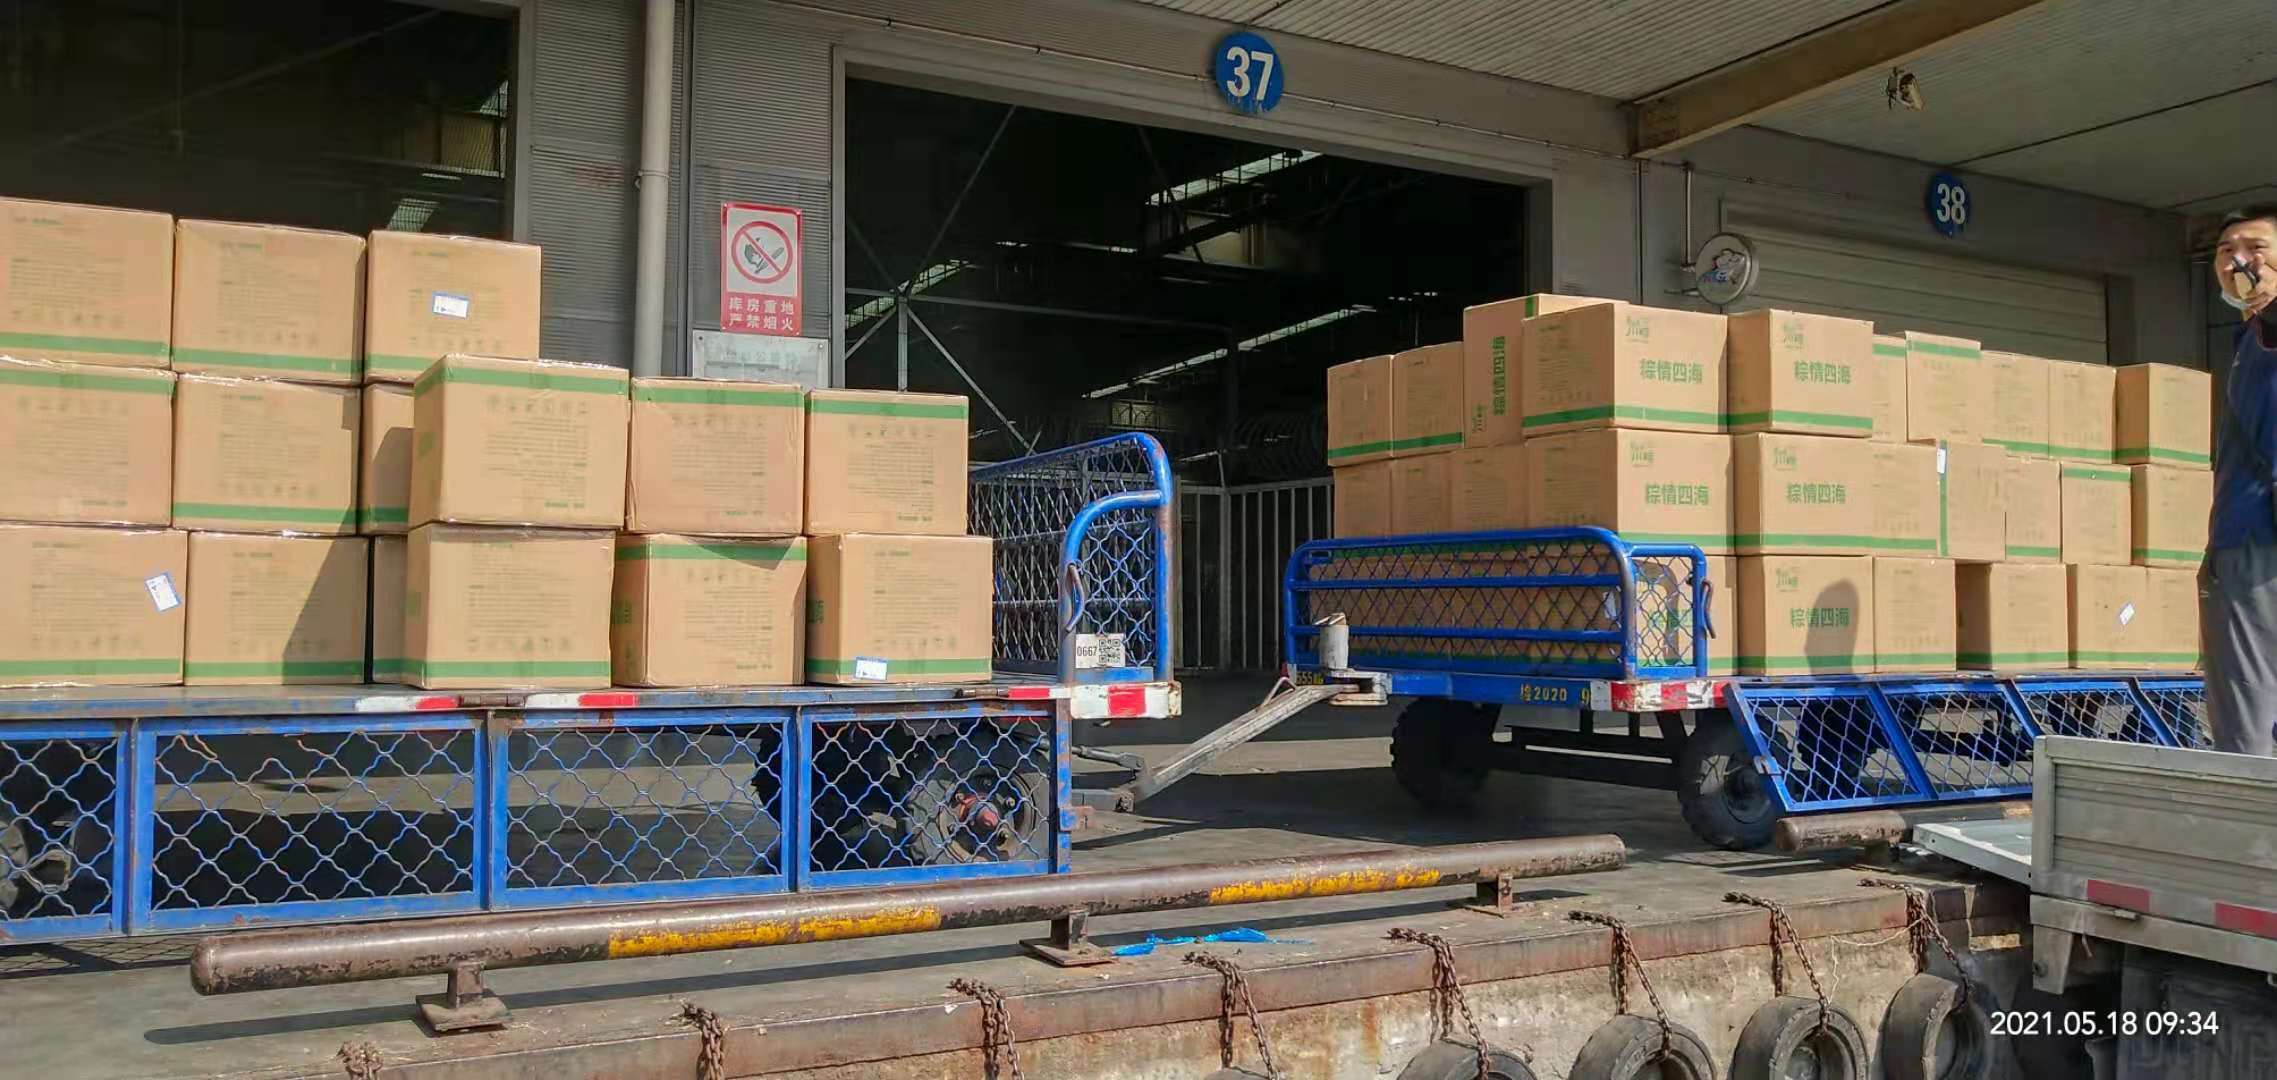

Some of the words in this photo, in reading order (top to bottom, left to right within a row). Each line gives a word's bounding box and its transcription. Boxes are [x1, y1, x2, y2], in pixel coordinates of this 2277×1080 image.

[1226, 46, 1274, 101] 37
[1936, 183, 1966, 225] 38
[728, 297, 794, 315] 库房重地
[728, 312, 794, 331] 严禁烟火
[1077, 646, 1097, 657] 0667
